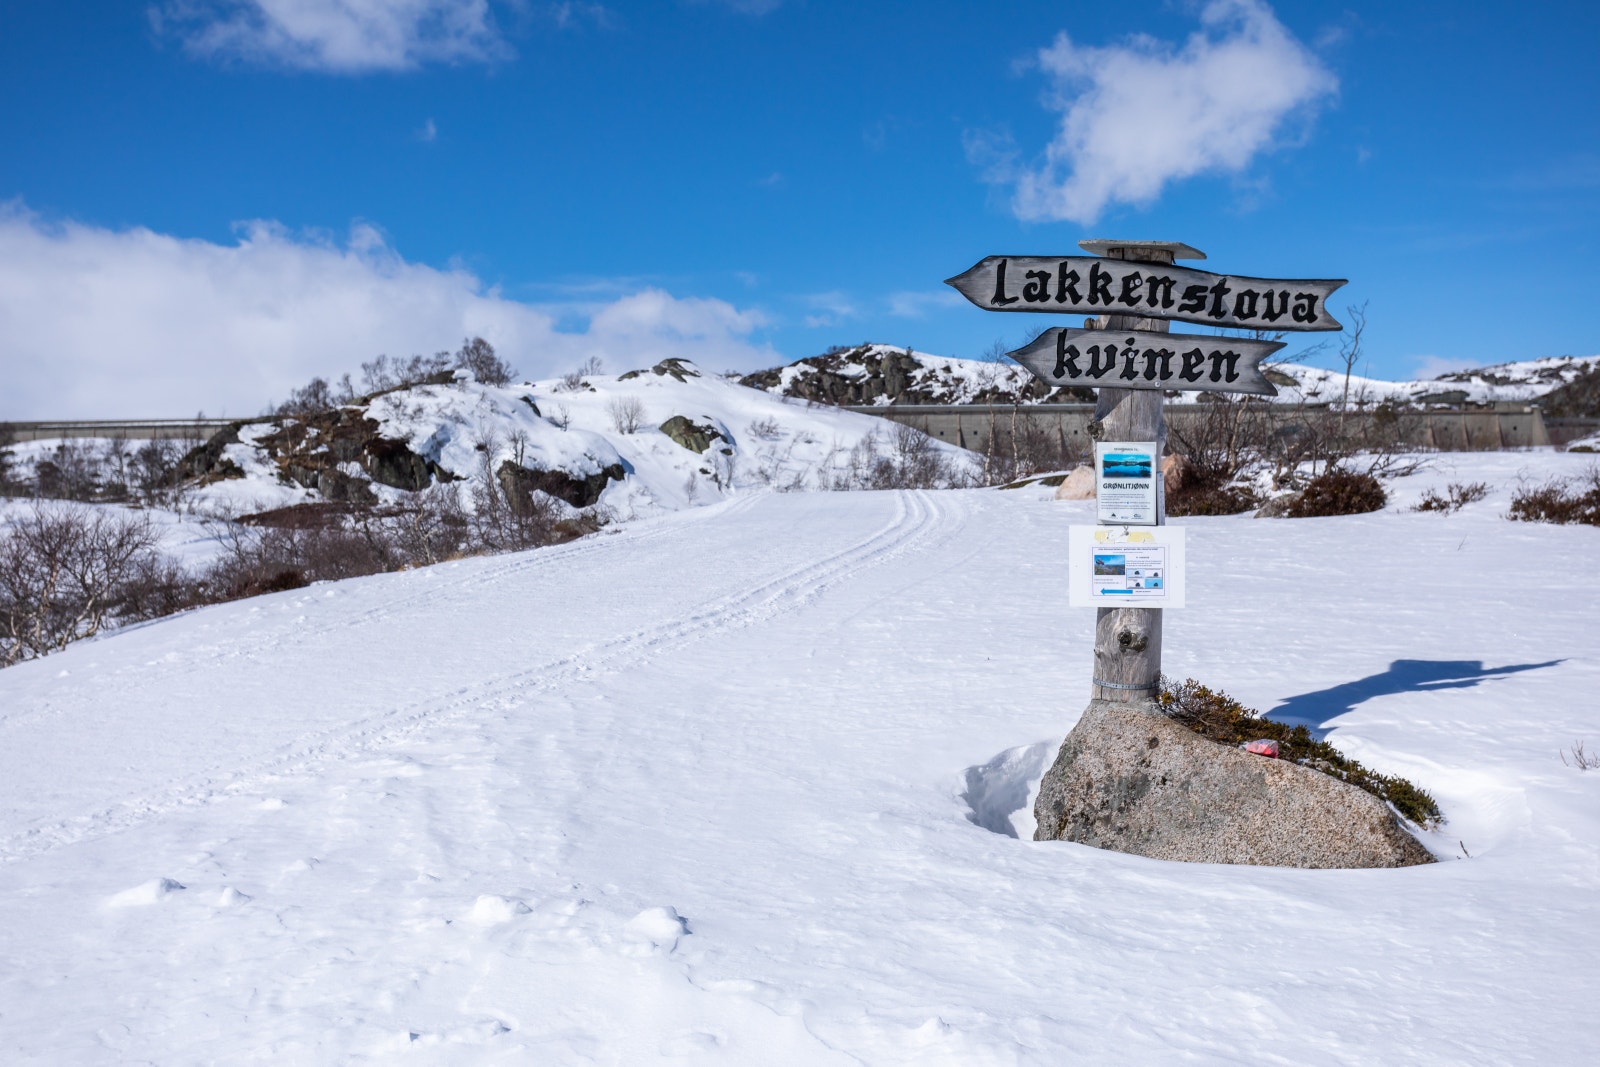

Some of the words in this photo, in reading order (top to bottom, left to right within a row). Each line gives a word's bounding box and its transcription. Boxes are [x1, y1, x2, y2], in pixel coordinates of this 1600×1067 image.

[991, 258, 1318, 324] Lakkenstova
[1053, 328, 1241, 383] kvinen
[1102, 482, 1150, 490] GRØNLITJØNN
